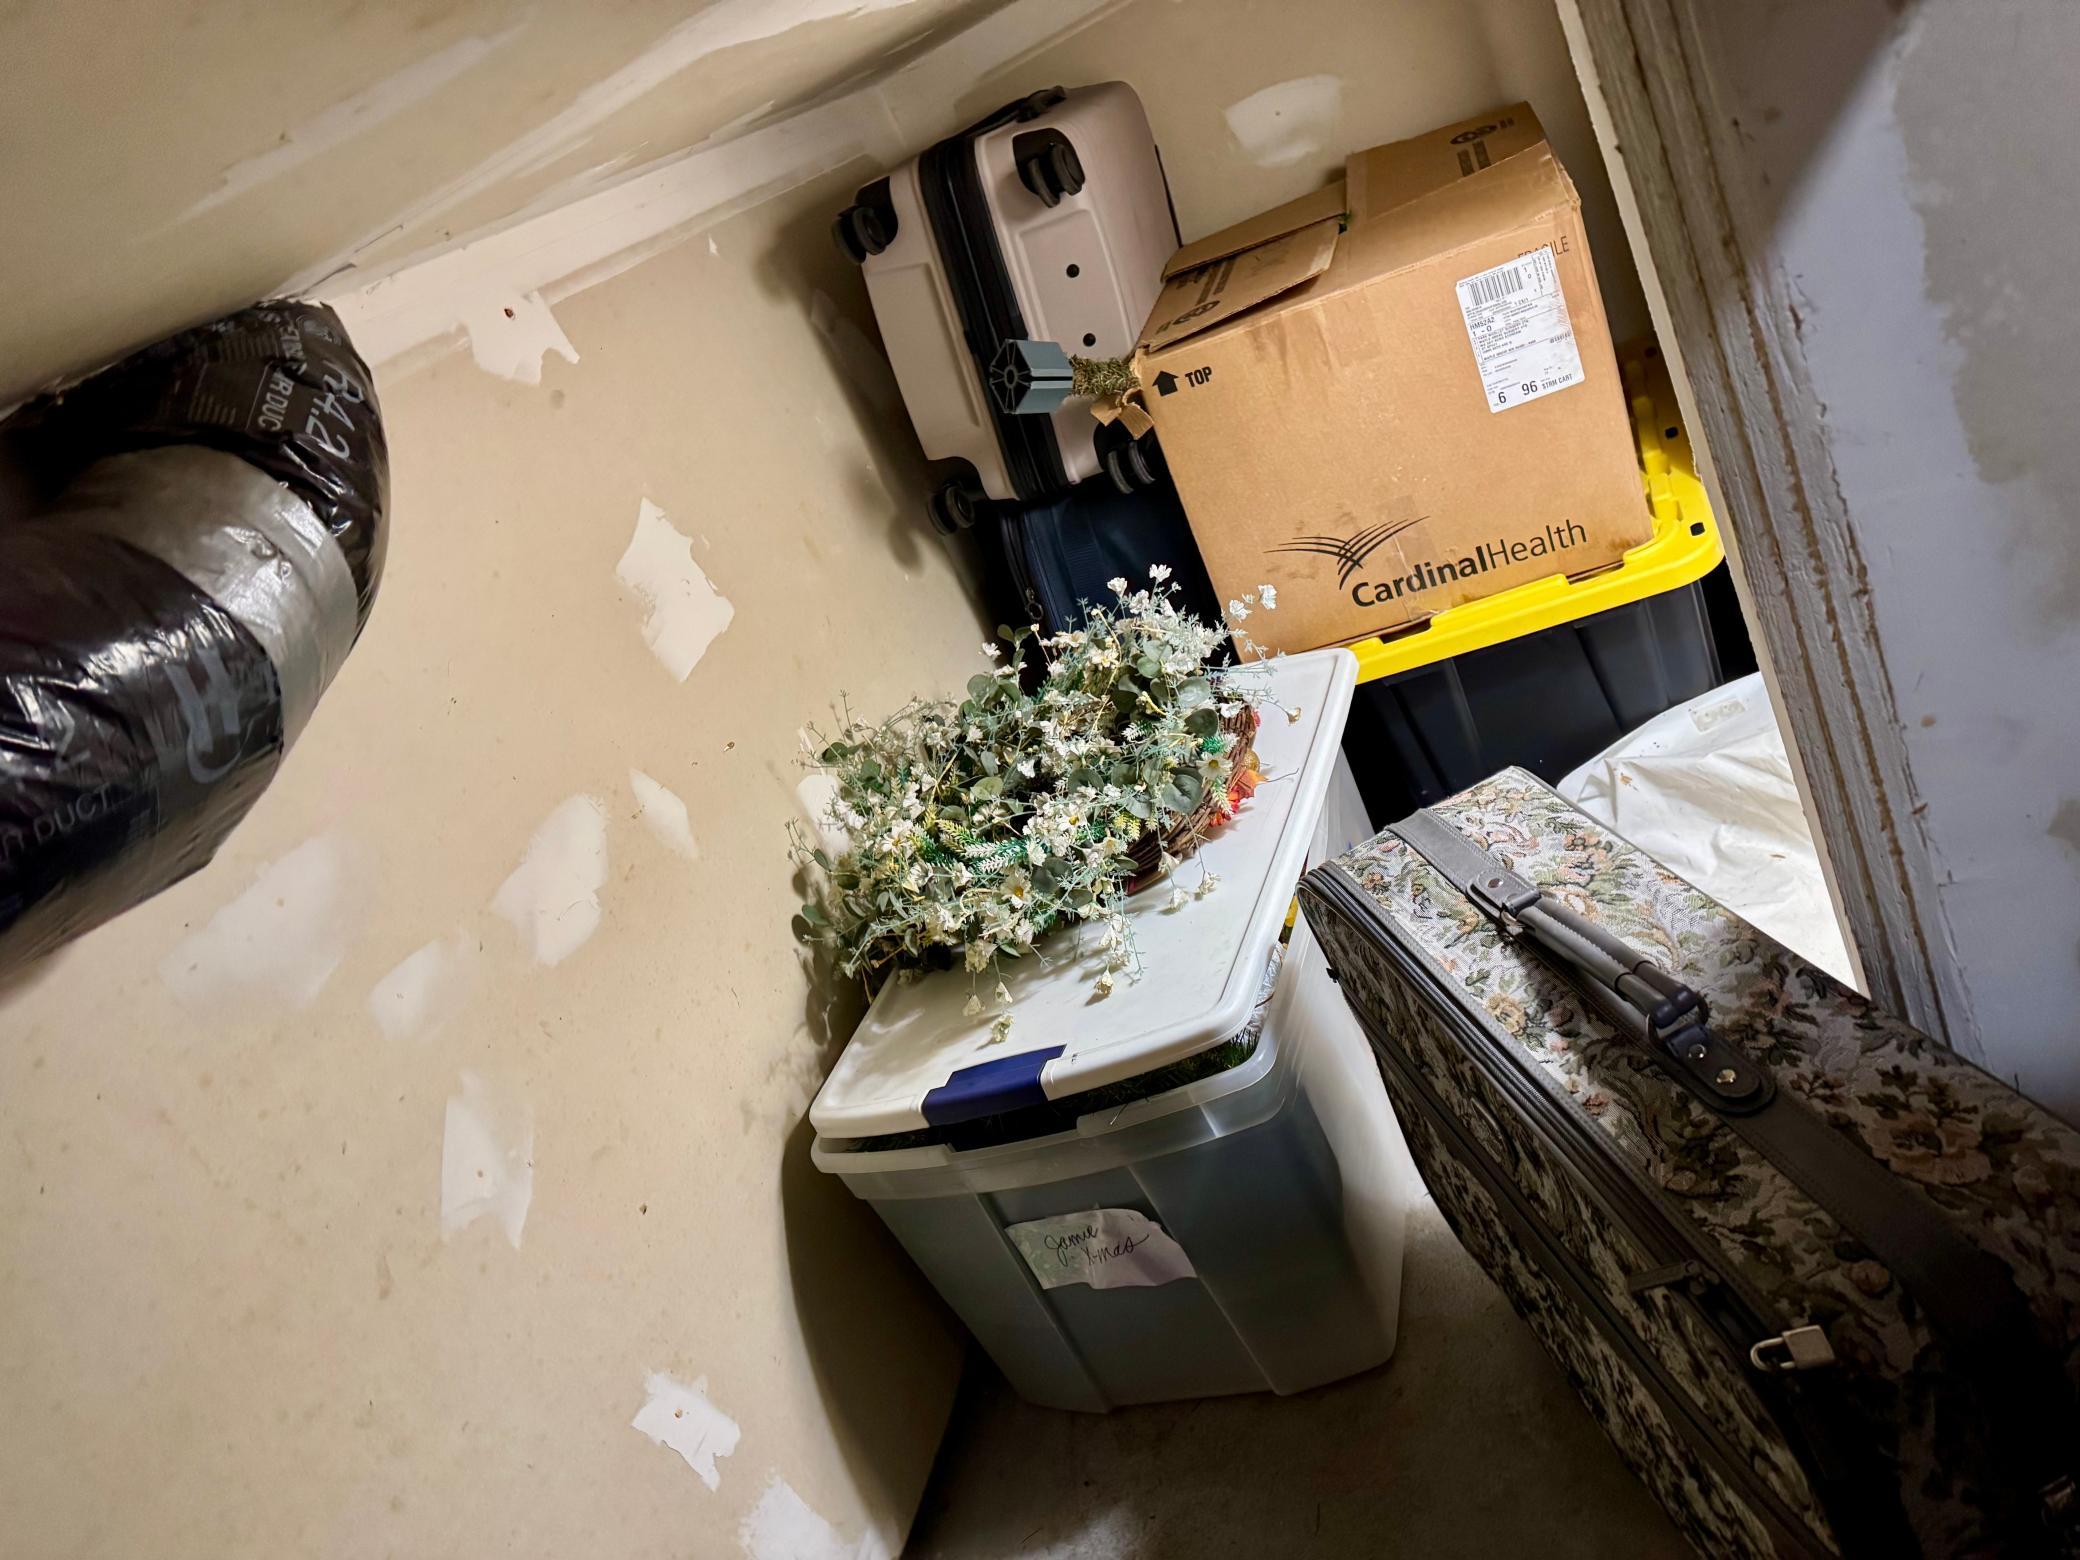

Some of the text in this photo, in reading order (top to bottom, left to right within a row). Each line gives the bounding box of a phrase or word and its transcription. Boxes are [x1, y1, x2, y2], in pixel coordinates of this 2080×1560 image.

[1184, 366, 1212, 388] TOP
[1498, 391, 1507, 404] 6
[1521, 380, 1538, 396] 96
[257, 392, 289, 431] DUC
[1351, 519, 1588, 608] CardinalHealth
[1044, 1225, 1099, 1268] Jamie
